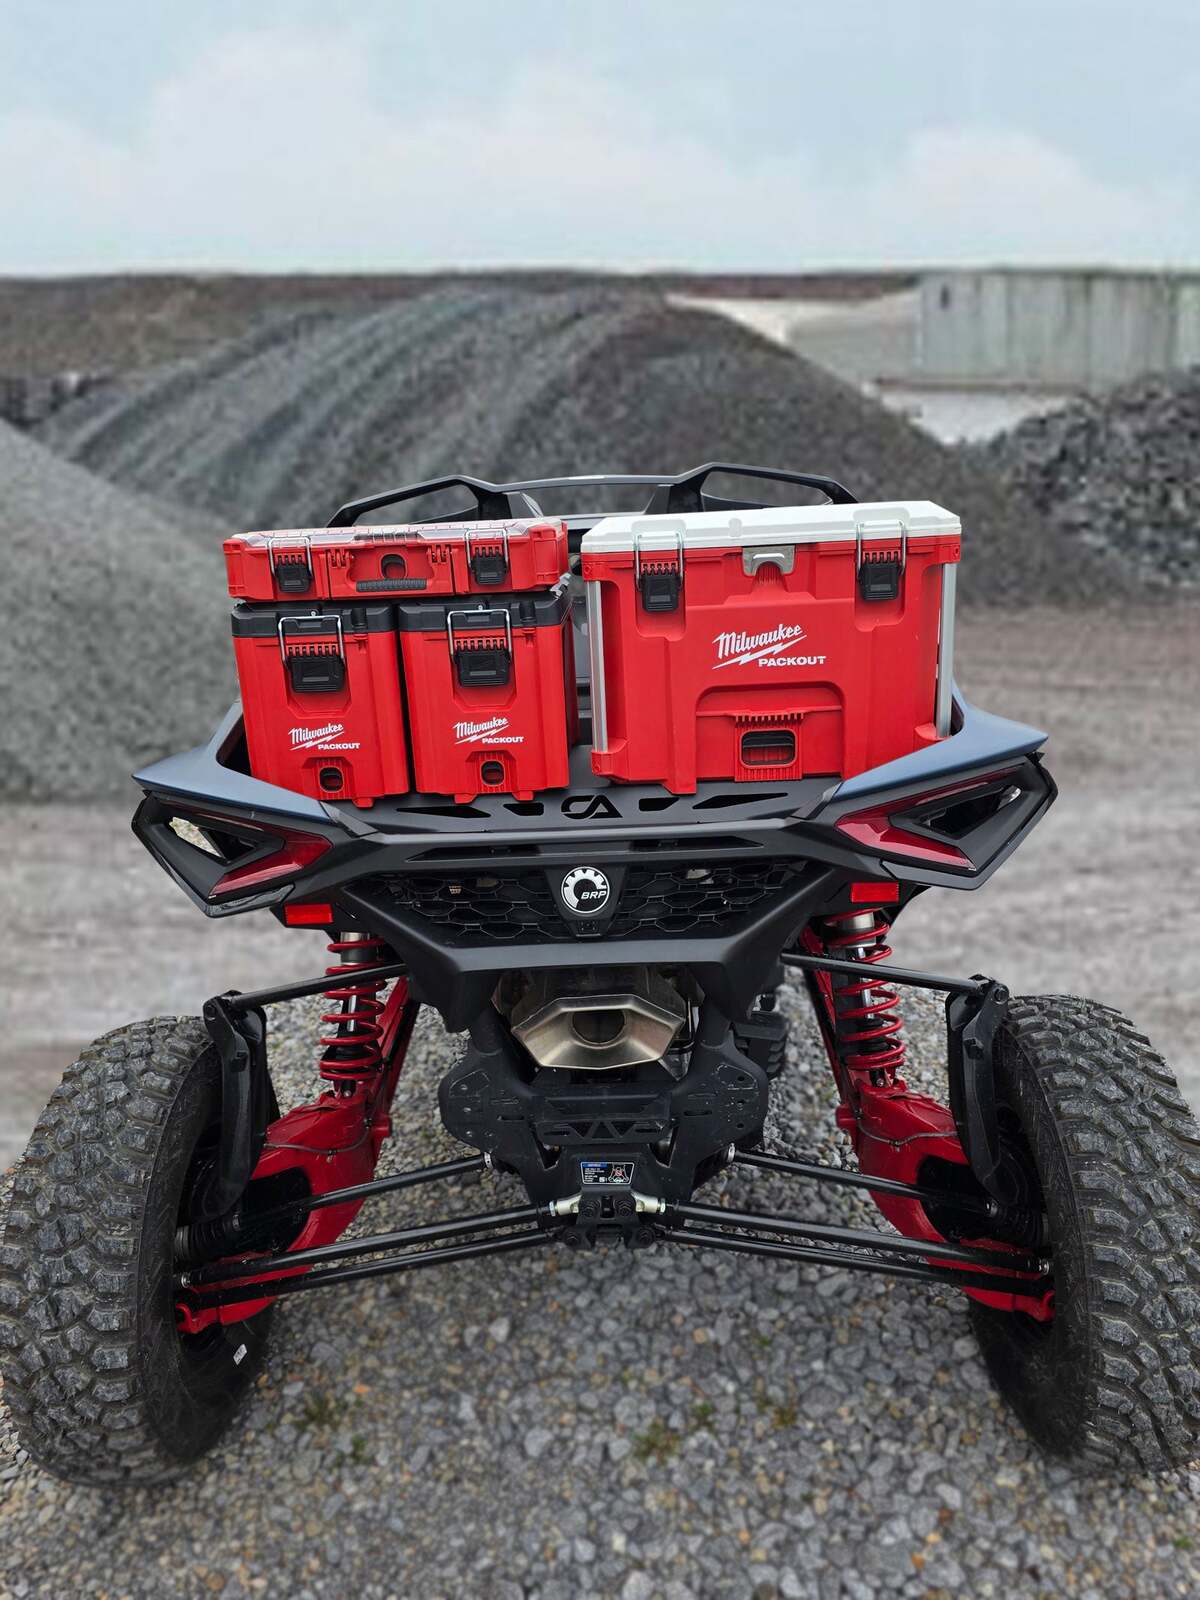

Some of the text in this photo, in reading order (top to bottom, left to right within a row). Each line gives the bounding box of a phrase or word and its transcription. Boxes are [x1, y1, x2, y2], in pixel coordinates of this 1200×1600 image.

[712, 624, 803, 659] Milwaukee
[758, 655, 827, 667] PACKOUT
[288, 723, 344, 744] Milwaukee
[453, 717, 509, 739] Milwaukee
[317, 742, 361, 750] PACKOUT
[482, 736, 524, 744] PACKOUT
[580, 890, 607, 900] BRP
